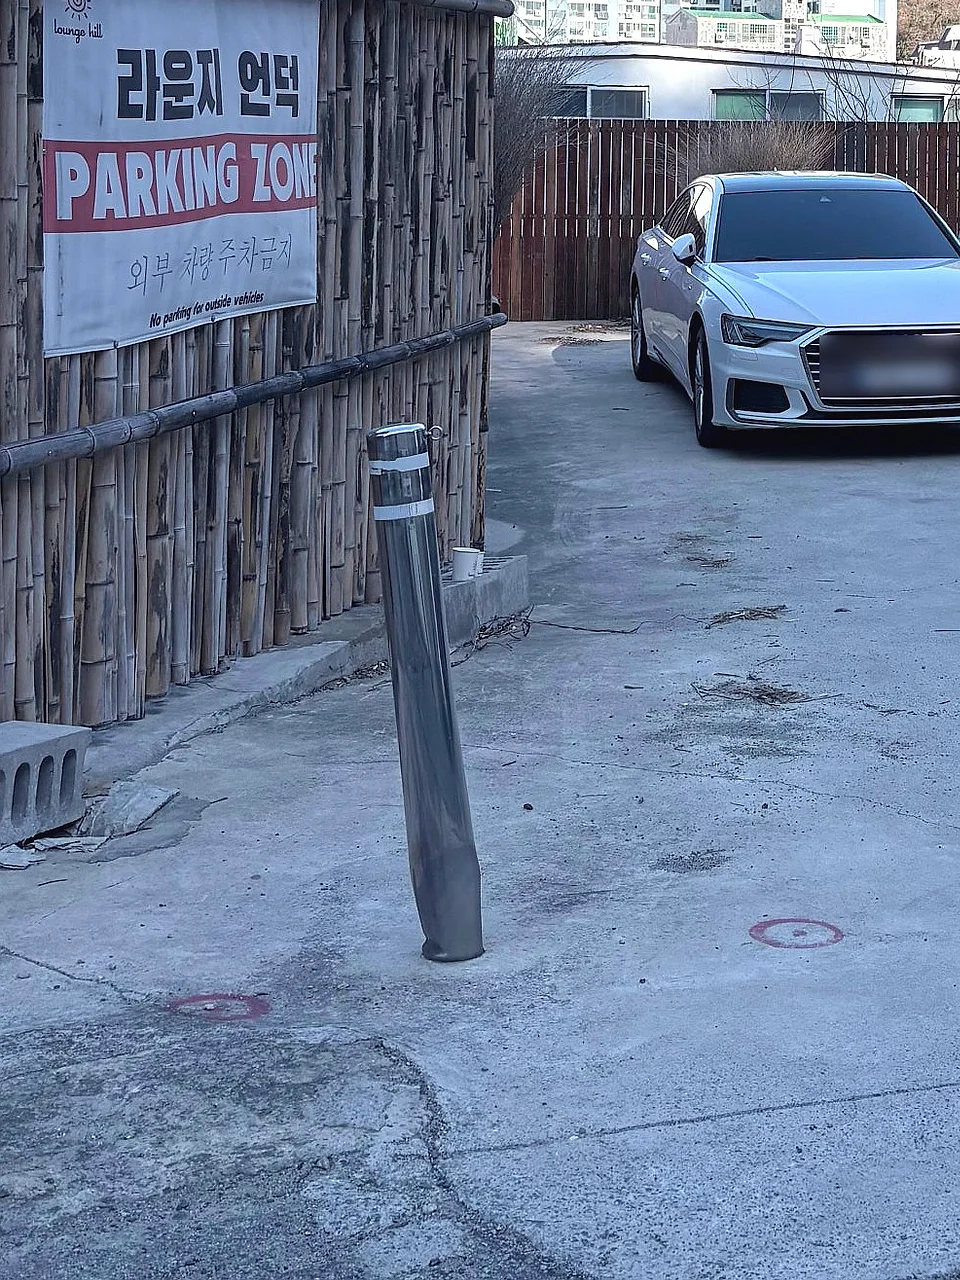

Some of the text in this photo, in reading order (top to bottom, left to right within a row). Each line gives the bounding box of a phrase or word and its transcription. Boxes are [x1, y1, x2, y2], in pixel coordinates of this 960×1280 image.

[53, 18, 103, 44] lounge hill
[117, 48, 299, 121] 라운지 언덕
[54, 141, 317, 220] PARKING ZONE
[127, 252, 173, 296] 외부
[150, 289, 265, 328] No parking for outside vehicles
